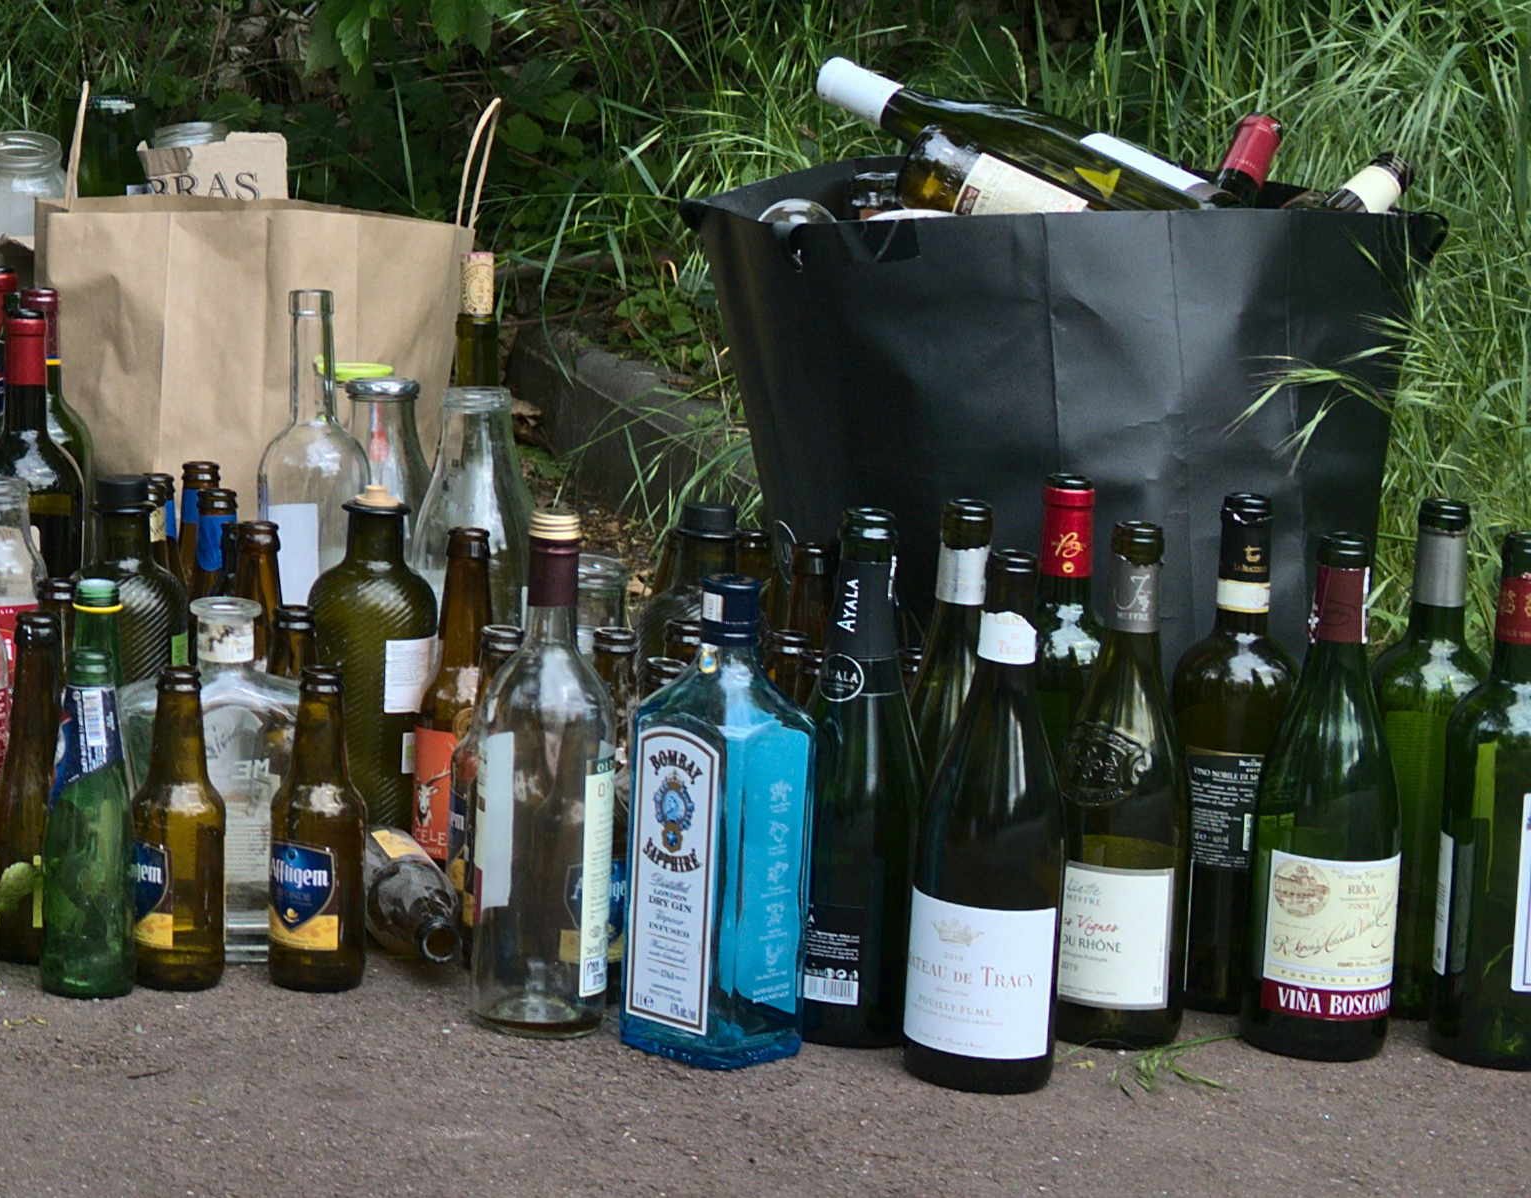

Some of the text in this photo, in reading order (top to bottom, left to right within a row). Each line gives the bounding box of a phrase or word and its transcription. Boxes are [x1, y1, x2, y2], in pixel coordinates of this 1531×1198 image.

[837, 578, 859, 633] AYALA
[649, 749, 704, 785] BOMBAY
[643, 838, 702, 874] SAPPHIRE
[1348, 884, 1377, 897] RIOJA
[648, 895, 692, 913] DRY GIN
[1078, 938, 1123, 954] RHÔNE
[953, 965, 1037, 989] DE TRACY
[918, 993, 957, 1013] POUILLY
[1277, 986, 1322, 1014] VIÑA
